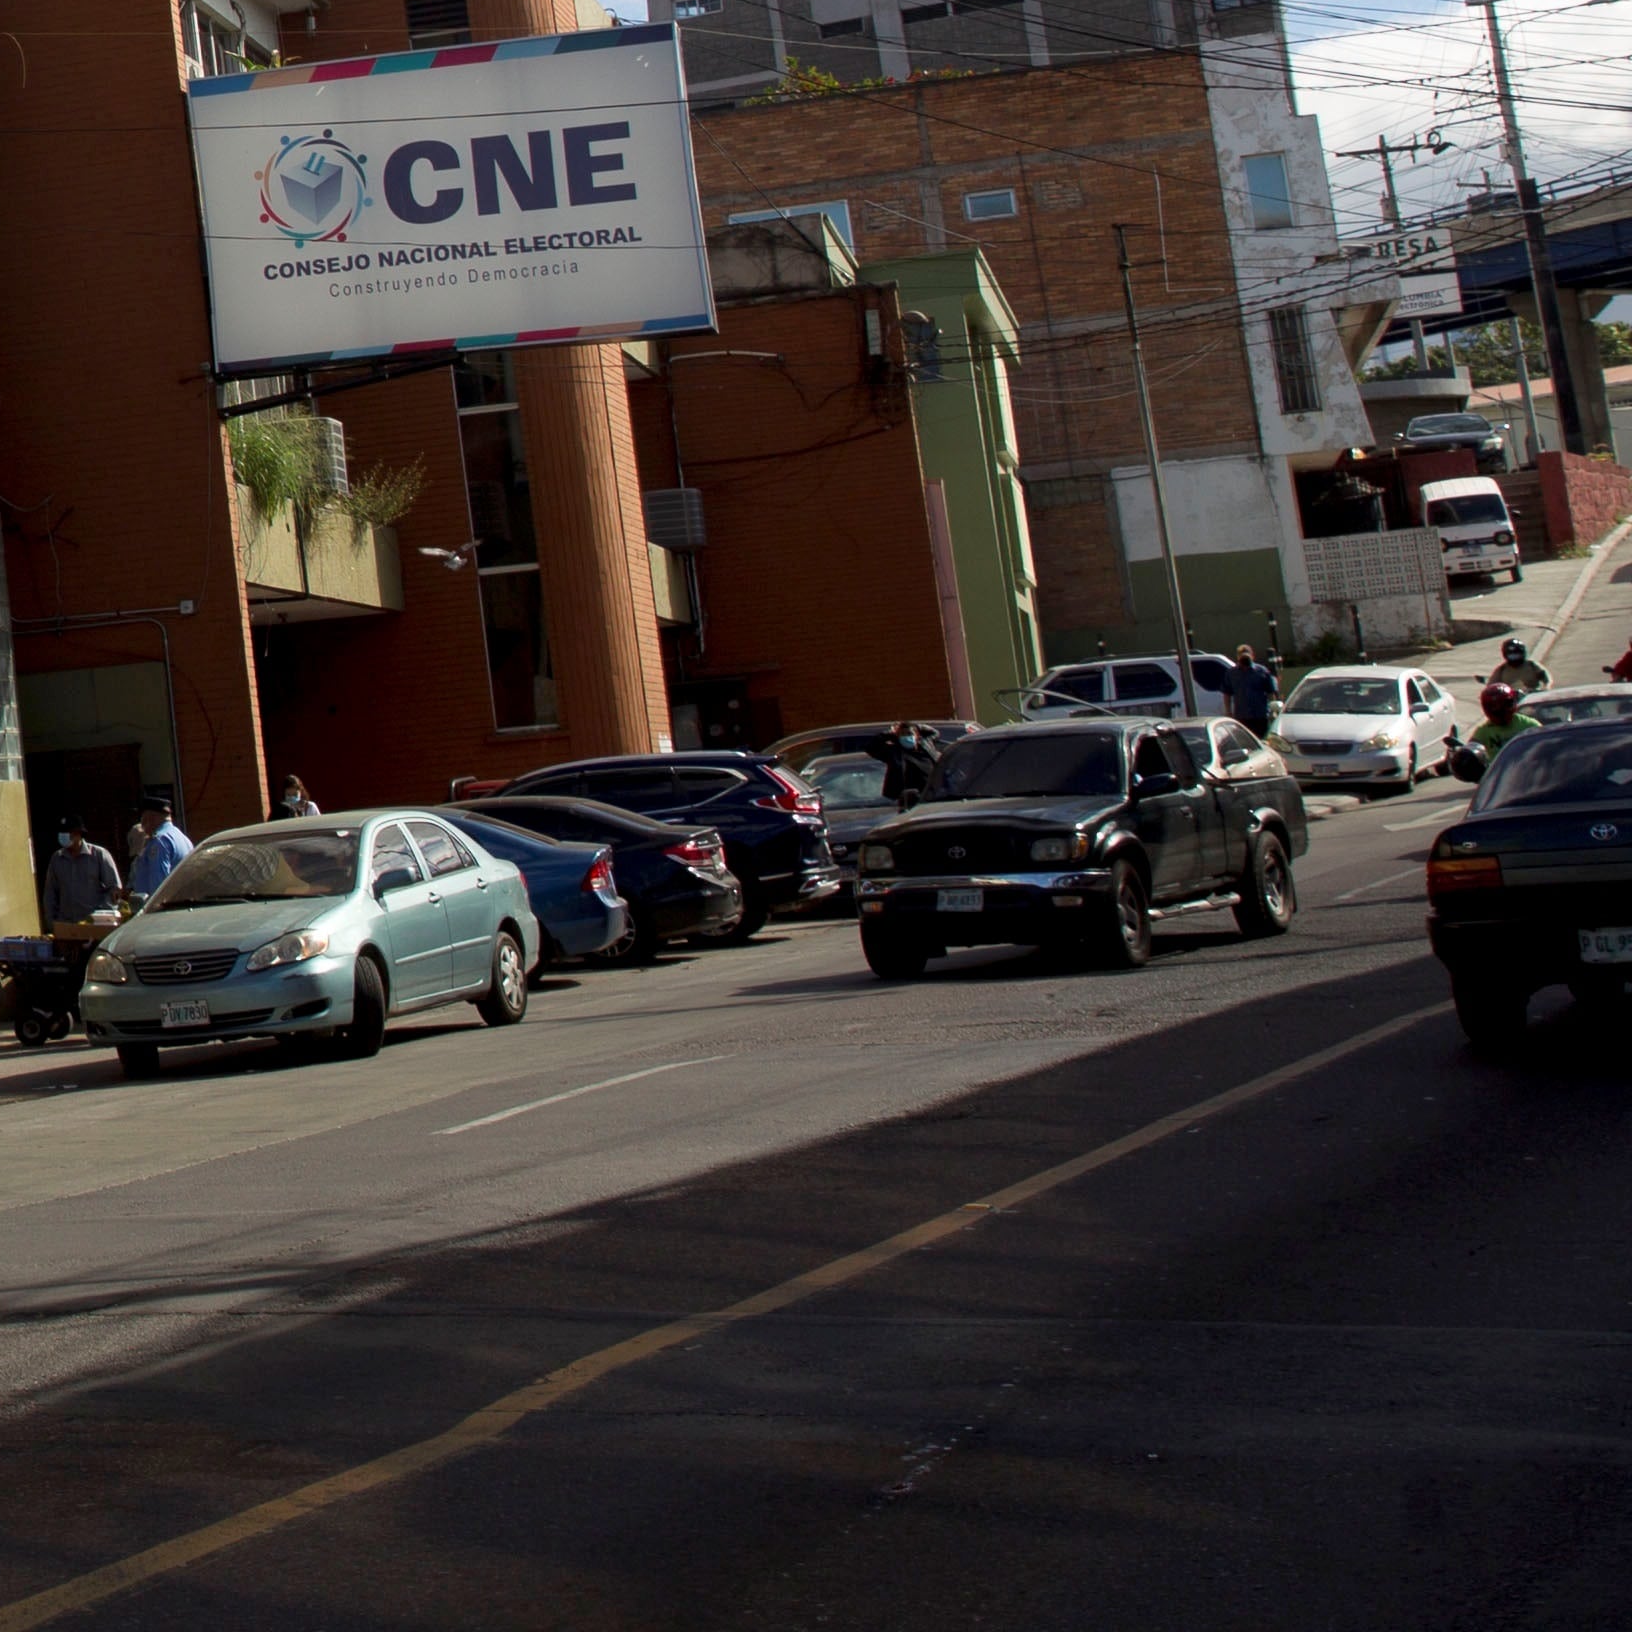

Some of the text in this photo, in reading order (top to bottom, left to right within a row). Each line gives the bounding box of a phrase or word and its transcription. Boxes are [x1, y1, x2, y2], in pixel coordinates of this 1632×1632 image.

[383, 120, 638, 225] CNE
[263, 226, 643, 281] CONSEJO NACIONAL ELECTORAL
[329, 259, 580, 298] Construyendo Democracia
